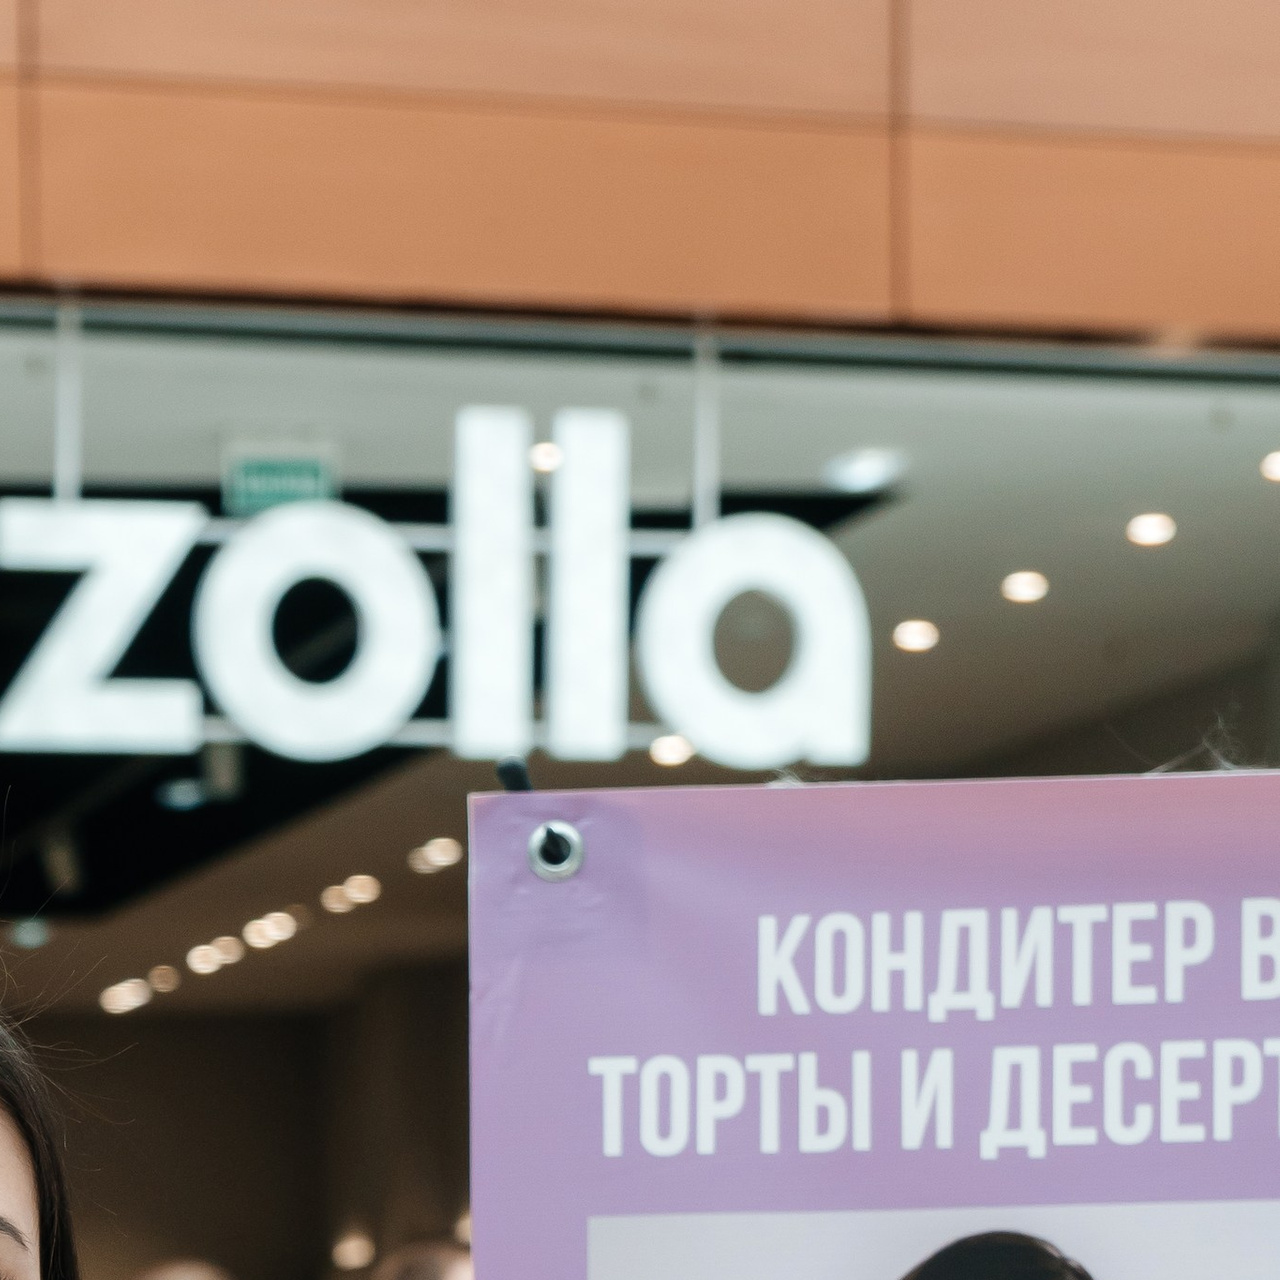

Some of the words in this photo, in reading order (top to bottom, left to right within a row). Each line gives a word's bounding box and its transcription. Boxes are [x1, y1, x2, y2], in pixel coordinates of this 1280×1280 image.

[758, 899, 1215, 1022] КОНДИТЕР
[588, 1049, 871, 1157] ТОРТЫ
[901, 1047, 954, 1150] И
